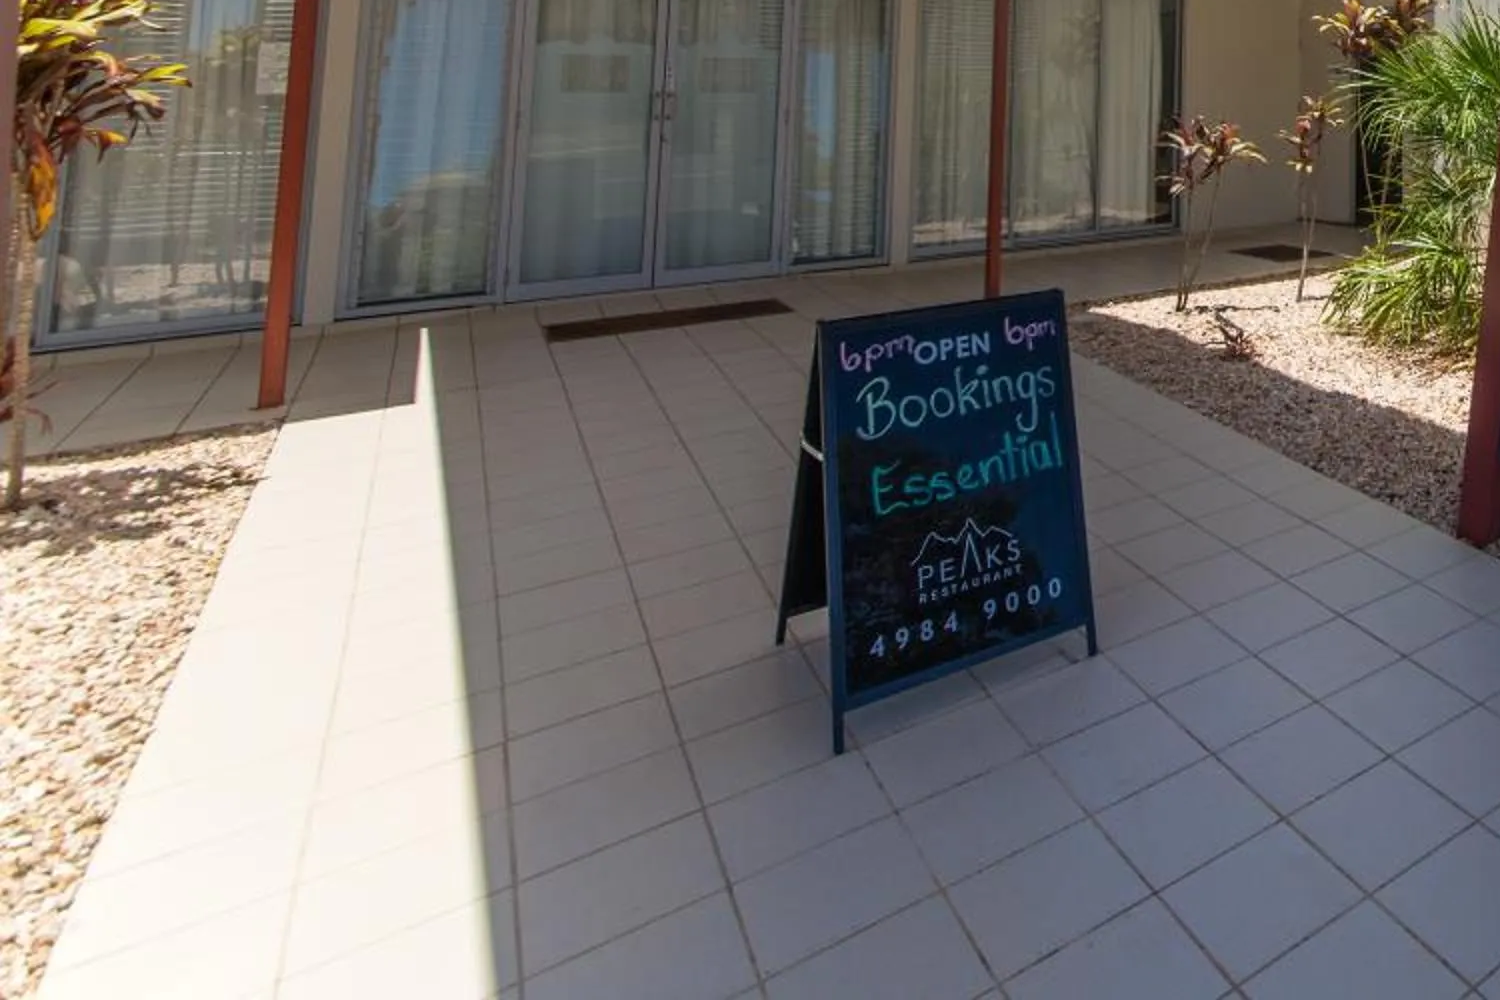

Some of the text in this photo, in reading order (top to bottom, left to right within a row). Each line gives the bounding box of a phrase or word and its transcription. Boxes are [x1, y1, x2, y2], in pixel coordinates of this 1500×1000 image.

[913, 331, 991, 365] OPEN
[856, 365, 1056, 441] Bookings
[871, 411, 1064, 516] Essential
[917, 532, 1022, 590] PEAKS
[918, 563, 1023, 604] RESTAURANT
[869, 577, 1062, 658] 4984 9000
